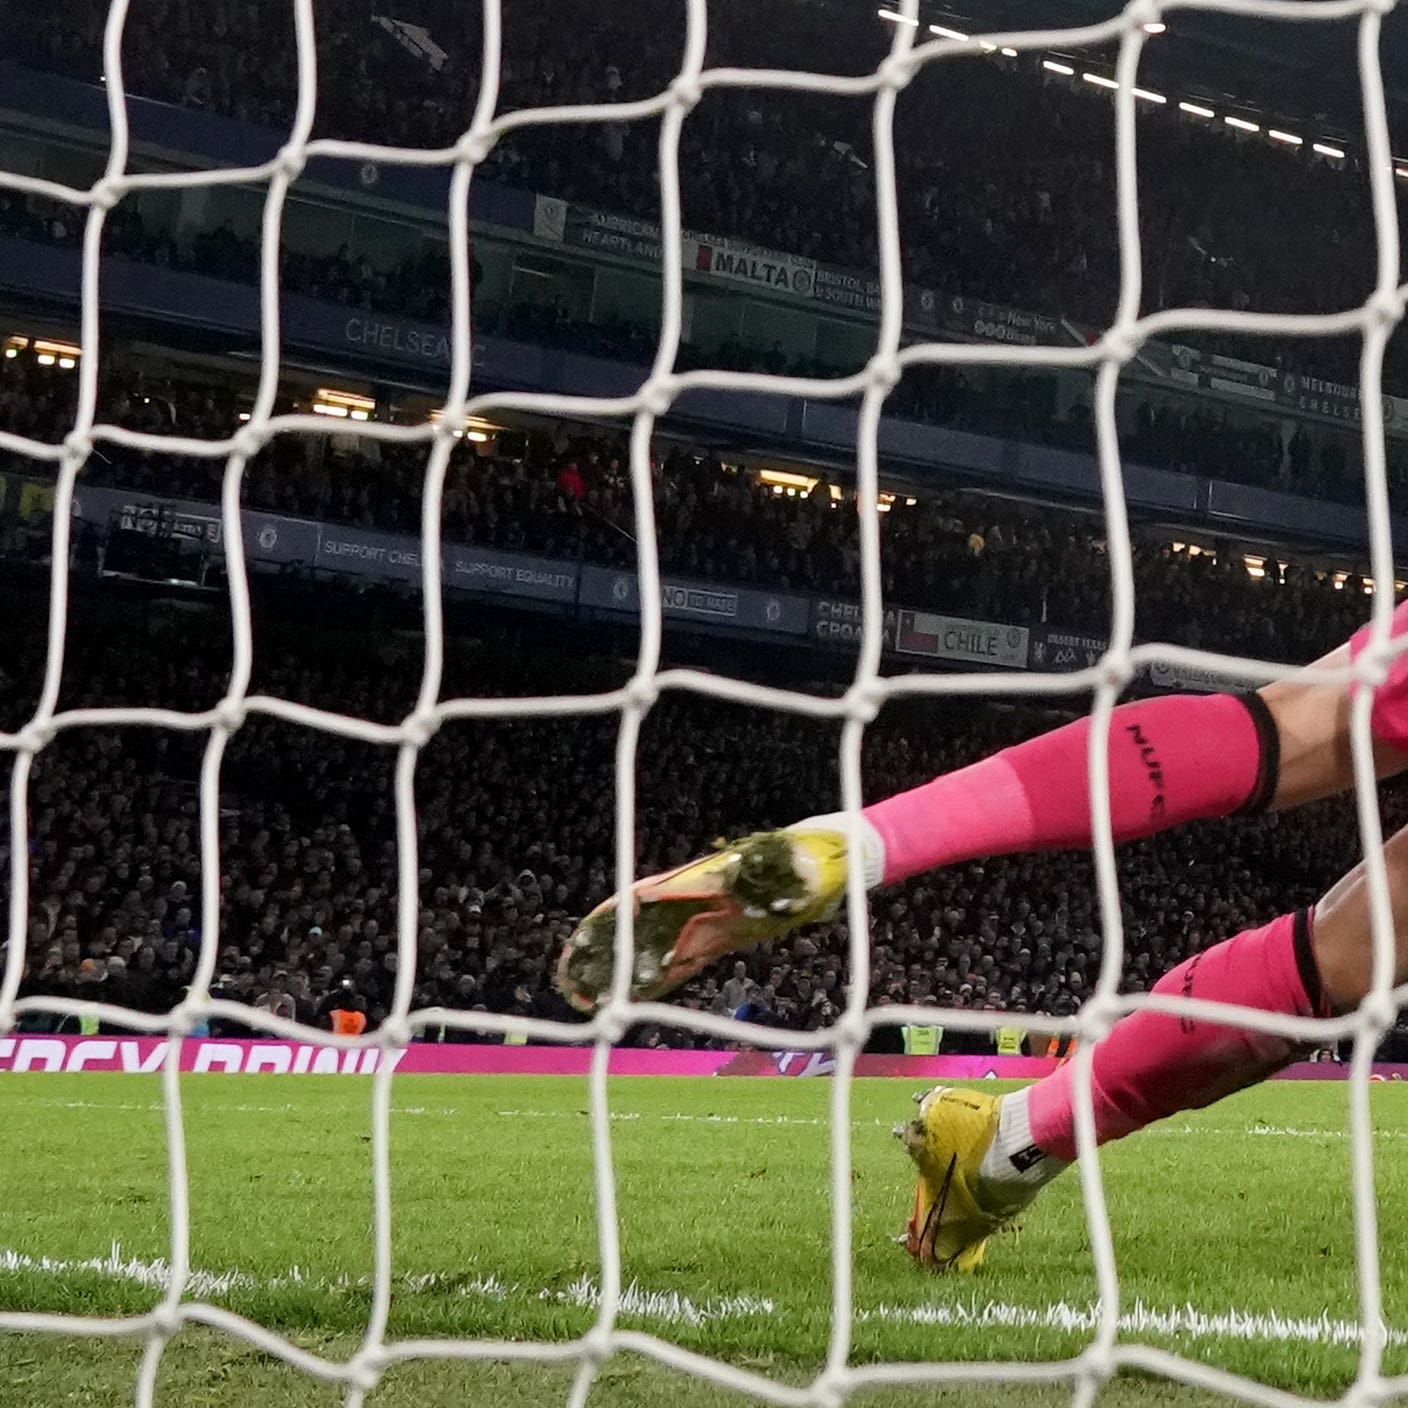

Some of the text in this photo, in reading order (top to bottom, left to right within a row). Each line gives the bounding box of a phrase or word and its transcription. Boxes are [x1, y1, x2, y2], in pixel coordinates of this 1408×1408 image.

[715, 253, 789, 288] MALTA
[346, 318, 451, 359] CHELSEA
[325, 541, 387, 561] SUPPORT
[455, 561, 576, 589] SUPPORT EQUALITY
[663, 588, 686, 607] NO
[944, 630, 997, 656] CHILE
